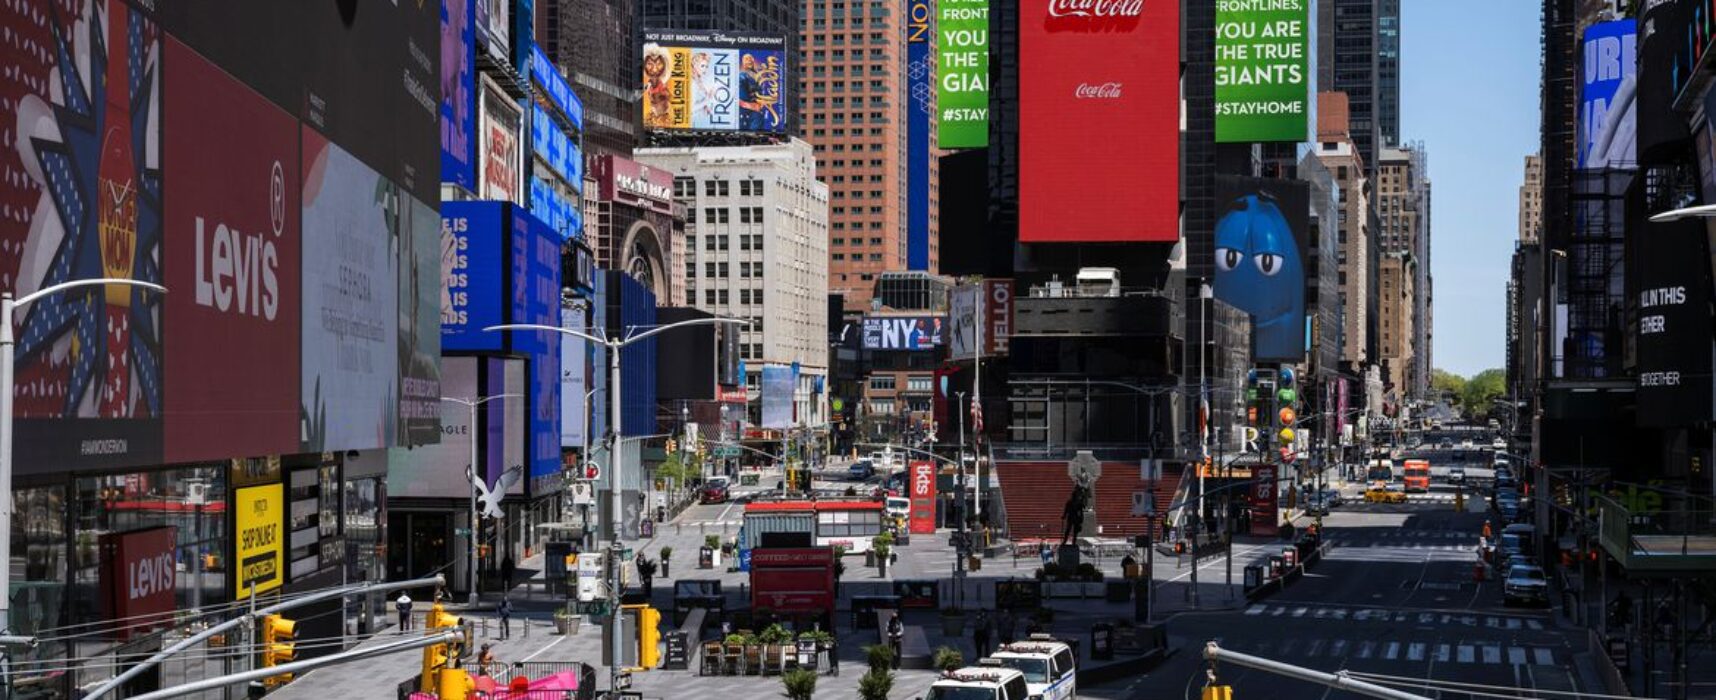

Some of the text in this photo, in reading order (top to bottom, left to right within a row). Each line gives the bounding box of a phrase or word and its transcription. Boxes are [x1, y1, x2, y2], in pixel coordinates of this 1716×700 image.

[1216, 0, 1302, 12] RONTLINES,
[909, 0, 929, 42] NO
[1215, 21, 1302, 39] YOU ARE
[661, 33, 674, 41] JUST
[676, 34, 711, 42] BROADWAY,
[711, 32, 736, 45] Disney
[749, 37, 783, 45] BROADWAY
[944, 29, 986, 47] YOU
[943, 51, 979, 67] THE
[1215, 43, 1302, 60] THE TRUE
[943, 72, 989, 92] GIA
[1215, 64, 1302, 86] GIANTS
[671, 52, 685, 125] THE LION KING
[710, 52, 734, 125] FROZEN
[755, 55, 779, 127] Aladdin
[943, 108, 989, 121] #STAY
[1215, 101, 1302, 115] #STAYHOME
[195, 216, 279, 321] Levi's
[1659, 286, 1686, 305] THIS
[993, 283, 1009, 352] HELLO!
[882, 319, 917, 349] NY
[916, 464, 932, 495] tkts
[129, 551, 173, 600] Levi's
